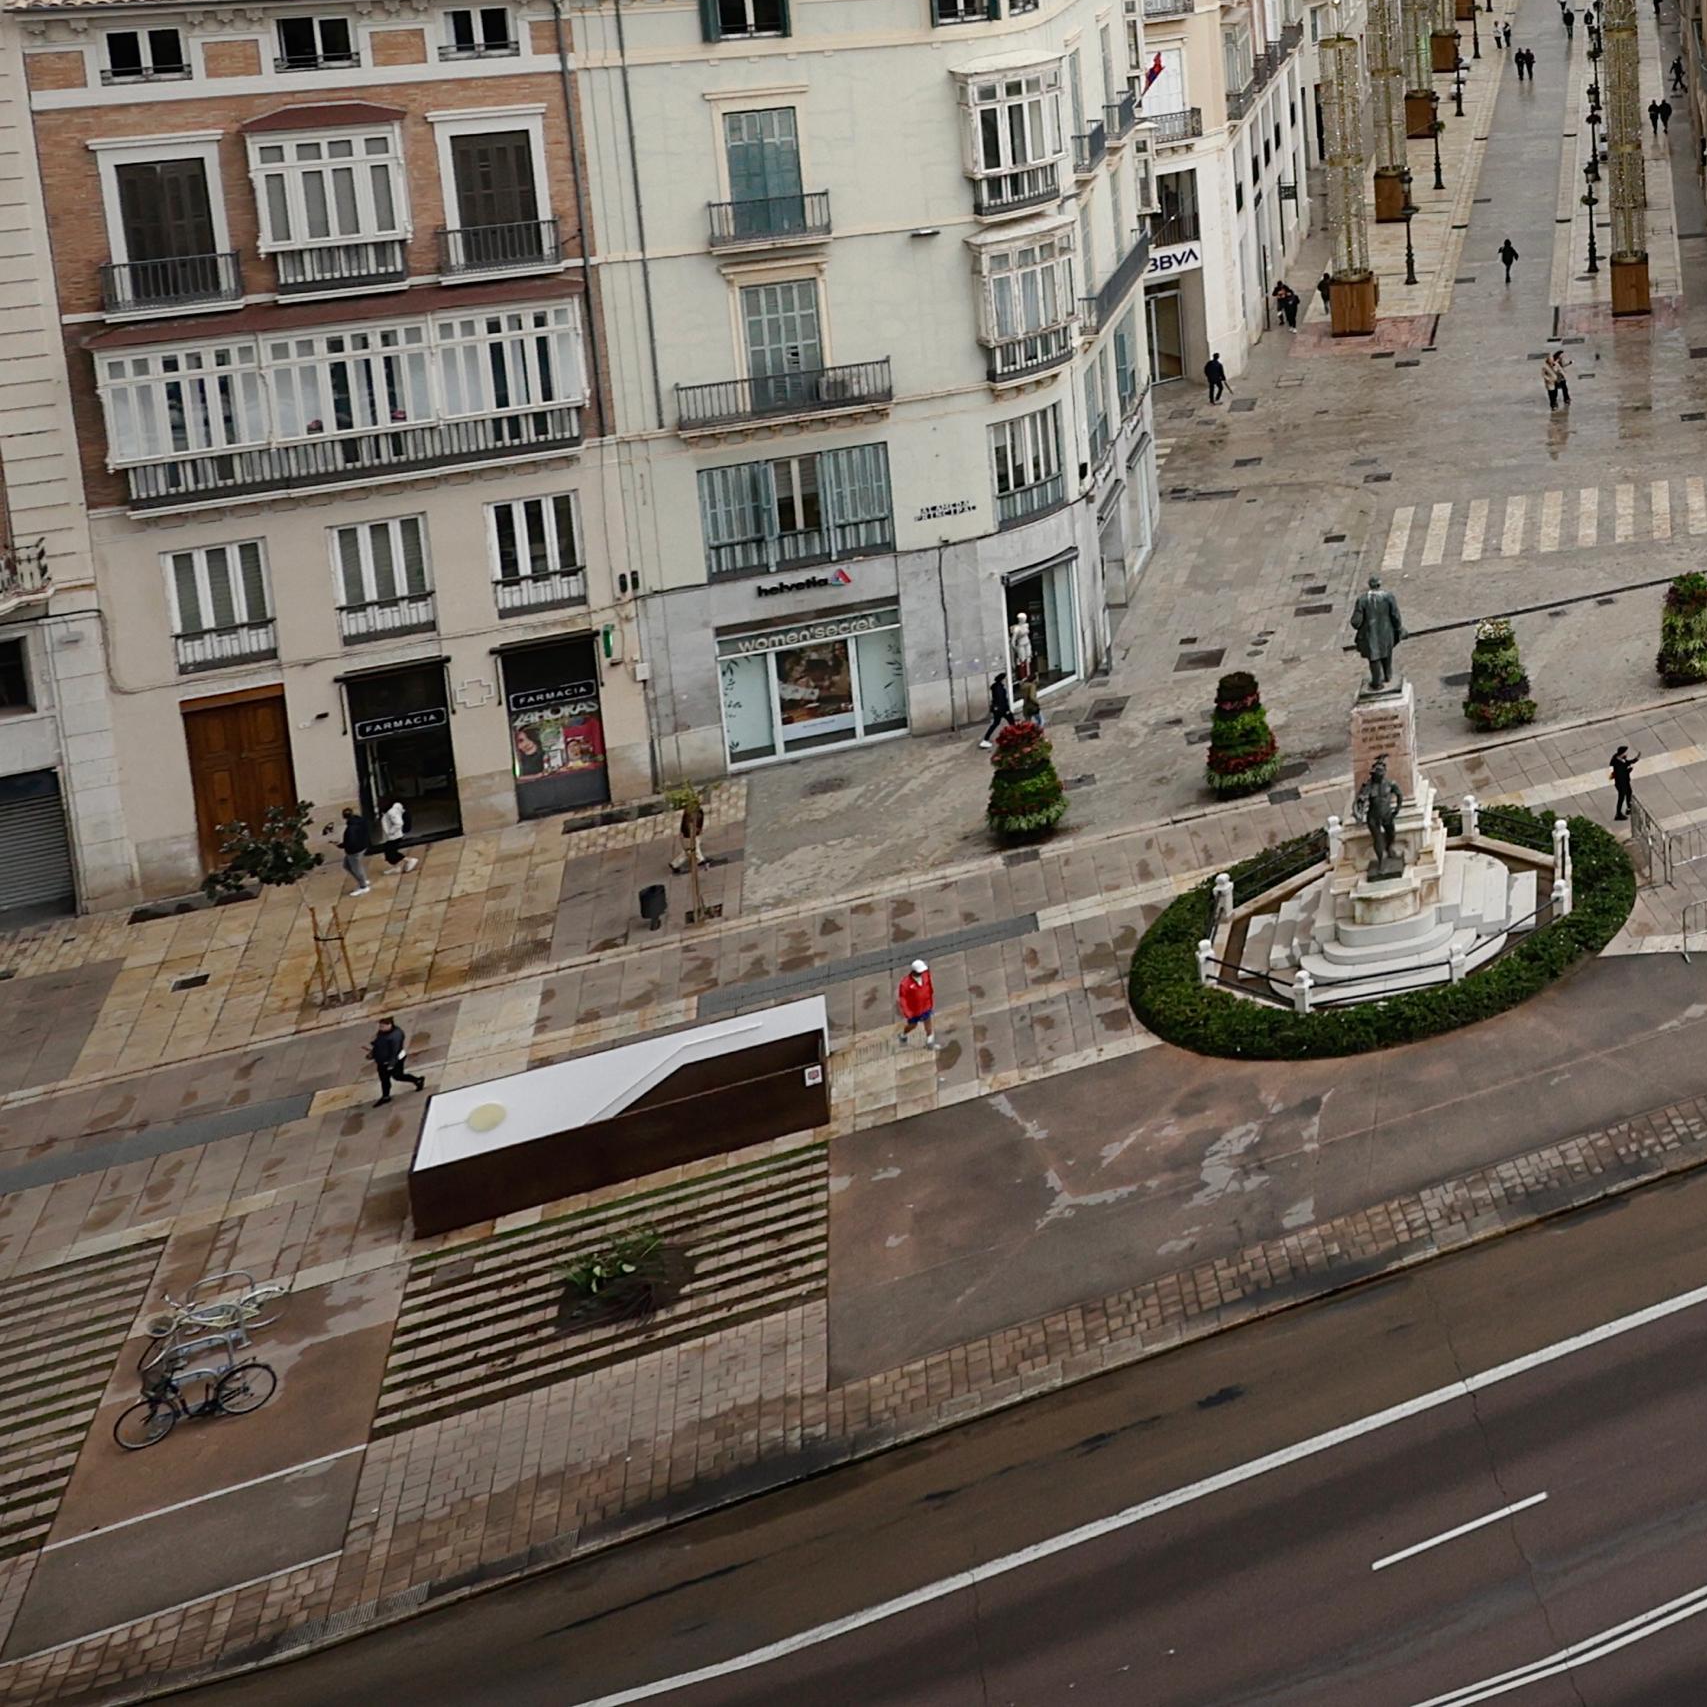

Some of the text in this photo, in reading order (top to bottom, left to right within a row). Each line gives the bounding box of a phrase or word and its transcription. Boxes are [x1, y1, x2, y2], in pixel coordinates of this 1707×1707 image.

[1147, 248, 1199, 274] BBVA
[757, 576, 828, 597] helvetia
[738, 615, 876, 653] women'secret
[519, 685, 587, 704] FARMACIA
[365, 714, 437, 733] FARMACIA
